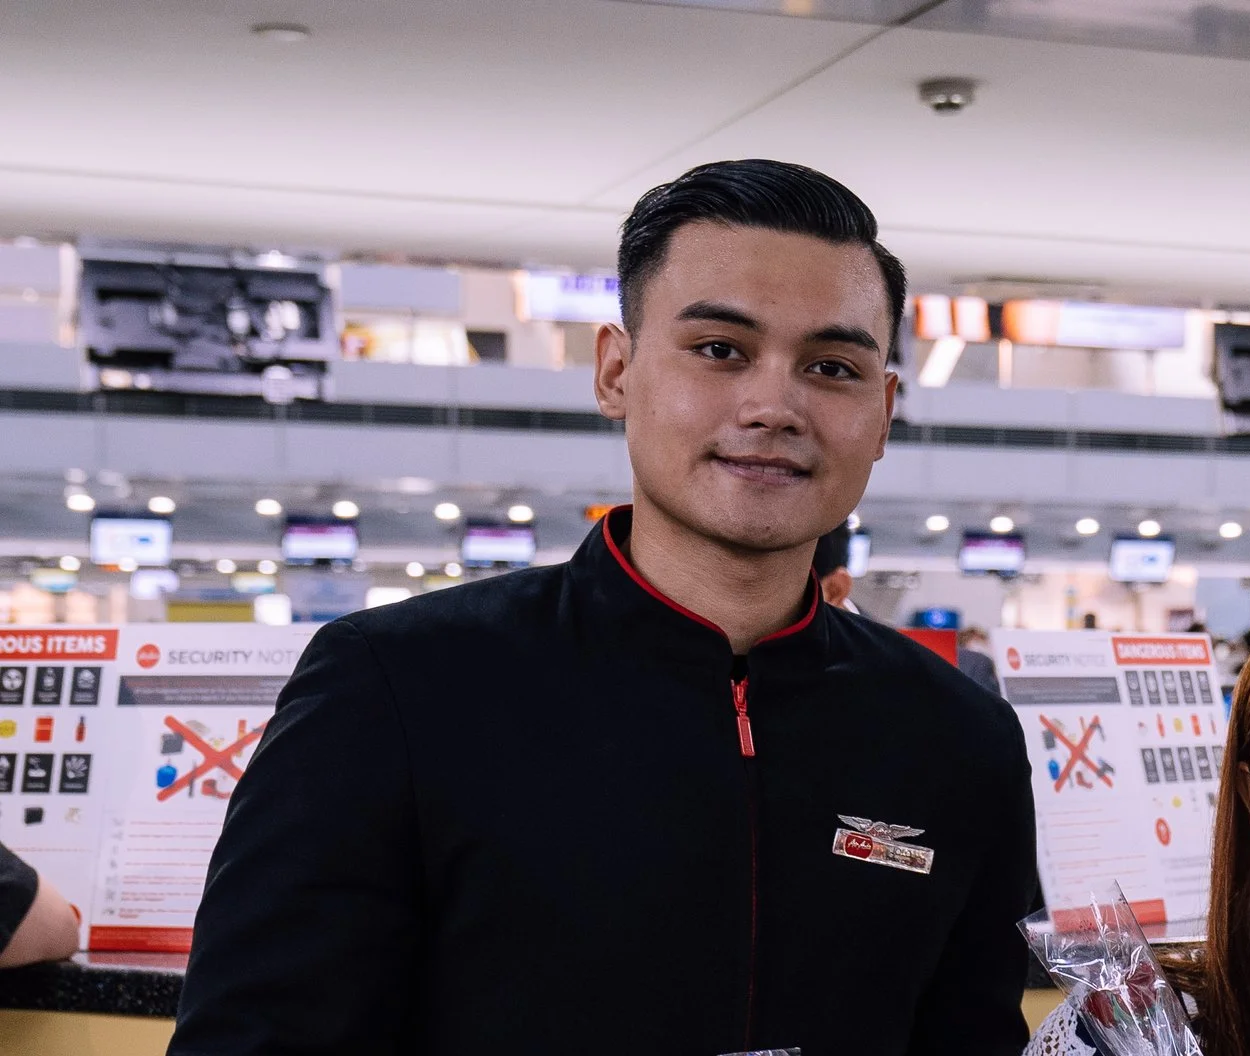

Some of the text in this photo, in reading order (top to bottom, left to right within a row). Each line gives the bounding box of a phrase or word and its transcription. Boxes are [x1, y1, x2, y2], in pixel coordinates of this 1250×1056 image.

[46, 634, 106, 653] ITEMS
[167, 650, 253, 664] SECURITY
[1117, 643, 1207, 660] DANGEROUS ITEMS
[1024, 653, 1069, 667] SECURITY
